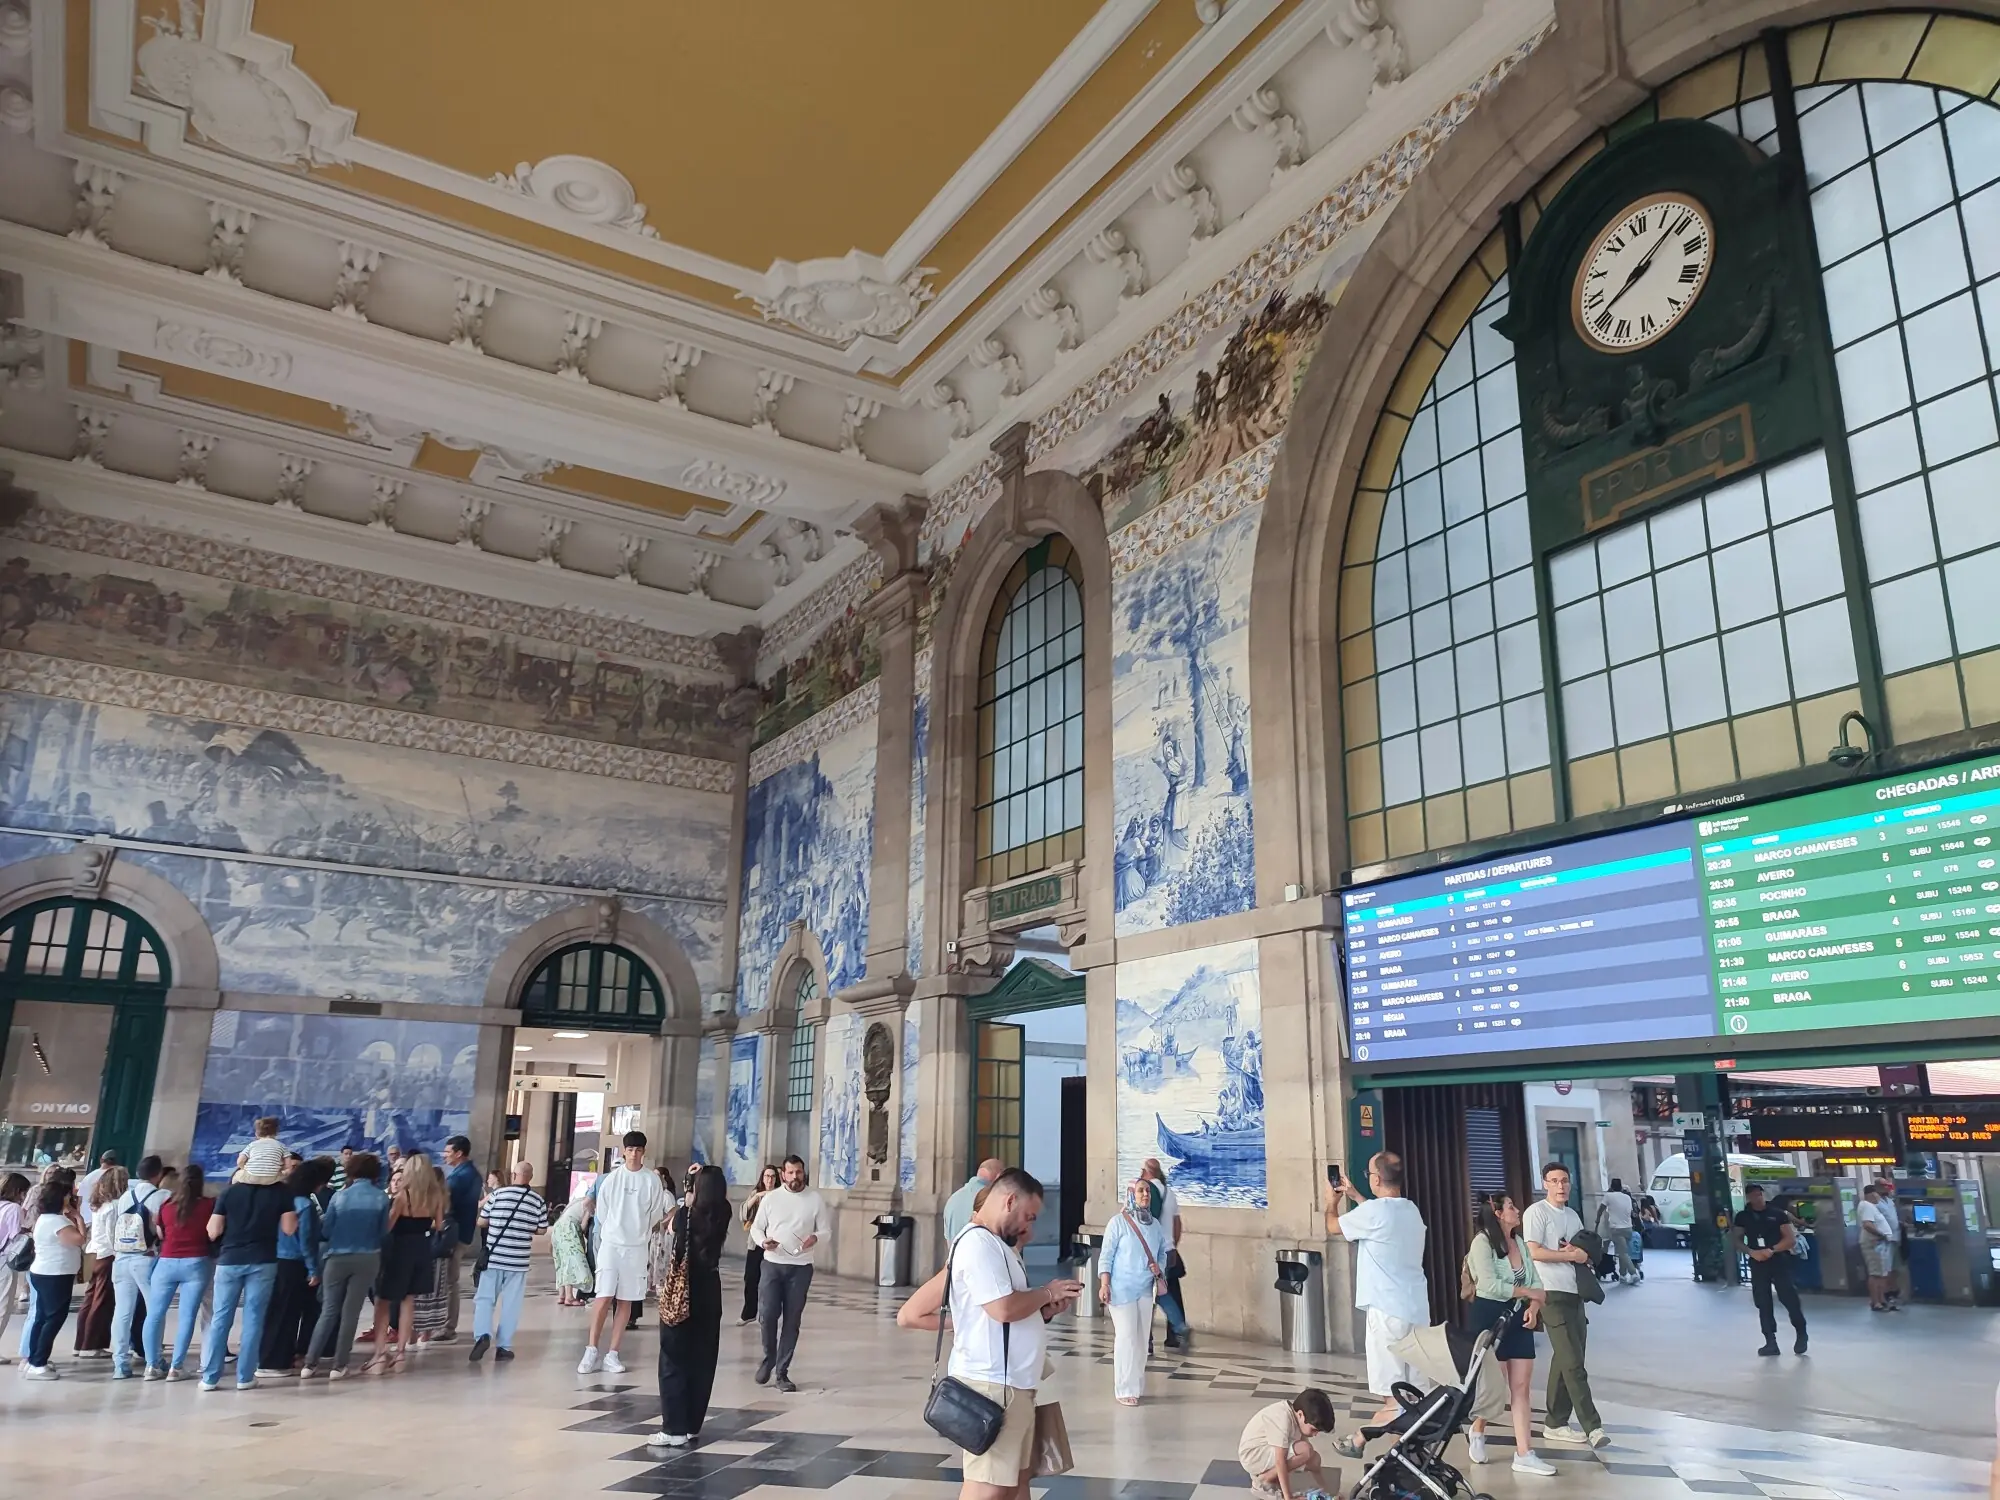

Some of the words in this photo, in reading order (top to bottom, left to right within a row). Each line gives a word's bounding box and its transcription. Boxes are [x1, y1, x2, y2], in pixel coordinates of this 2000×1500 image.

[1608, 428, 1720, 496] PORTO
[1876, 774, 1958, 800] CHEGADAS
[1754, 849, 1792, 862] MARCO
[1794, 837, 1858, 855] CANAVESES
[1879, 832, 1886, 840] 3
[1906, 825, 1928, 835] SUBU
[1445, 869, 1486, 886] PARTIDAS
[1492, 856, 1553, 876] DEPARTURES
[1710, 879, 1734, 890] 20:30
[1757, 869, 1794, 882] AVEIRO
[1882, 852, 1890, 862] 5
[1909, 847, 1931, 856] SUBU
[994, 881, 1056, 914] ENTRADA
[1760, 887, 1806, 902] POCINHO
[1886, 874, 1891, 883] 1
[1762, 909, 1800, 922] BRAGA
[1889, 895, 1896, 904] 4
[1916, 890, 1938, 900] SUBU
[1765, 926, 1827, 942] GUIMARÃES
[1892, 916, 1900, 926] 4
[1920, 912, 1942, 921] SUBU
[1768, 950, 1806, 962] MARCO
[1808, 942, 1874, 958] CANAVESES
[1923, 934, 1946, 943] SUBU
[1771, 971, 1809, 983] AVEIRO
[1899, 960, 1906, 969] 6
[1927, 956, 1949, 965] SUBU
[1773, 991, 1811, 1003] BRAGA
[1902, 982, 1910, 992] 6
[1931, 979, 1953, 988] SUBU
